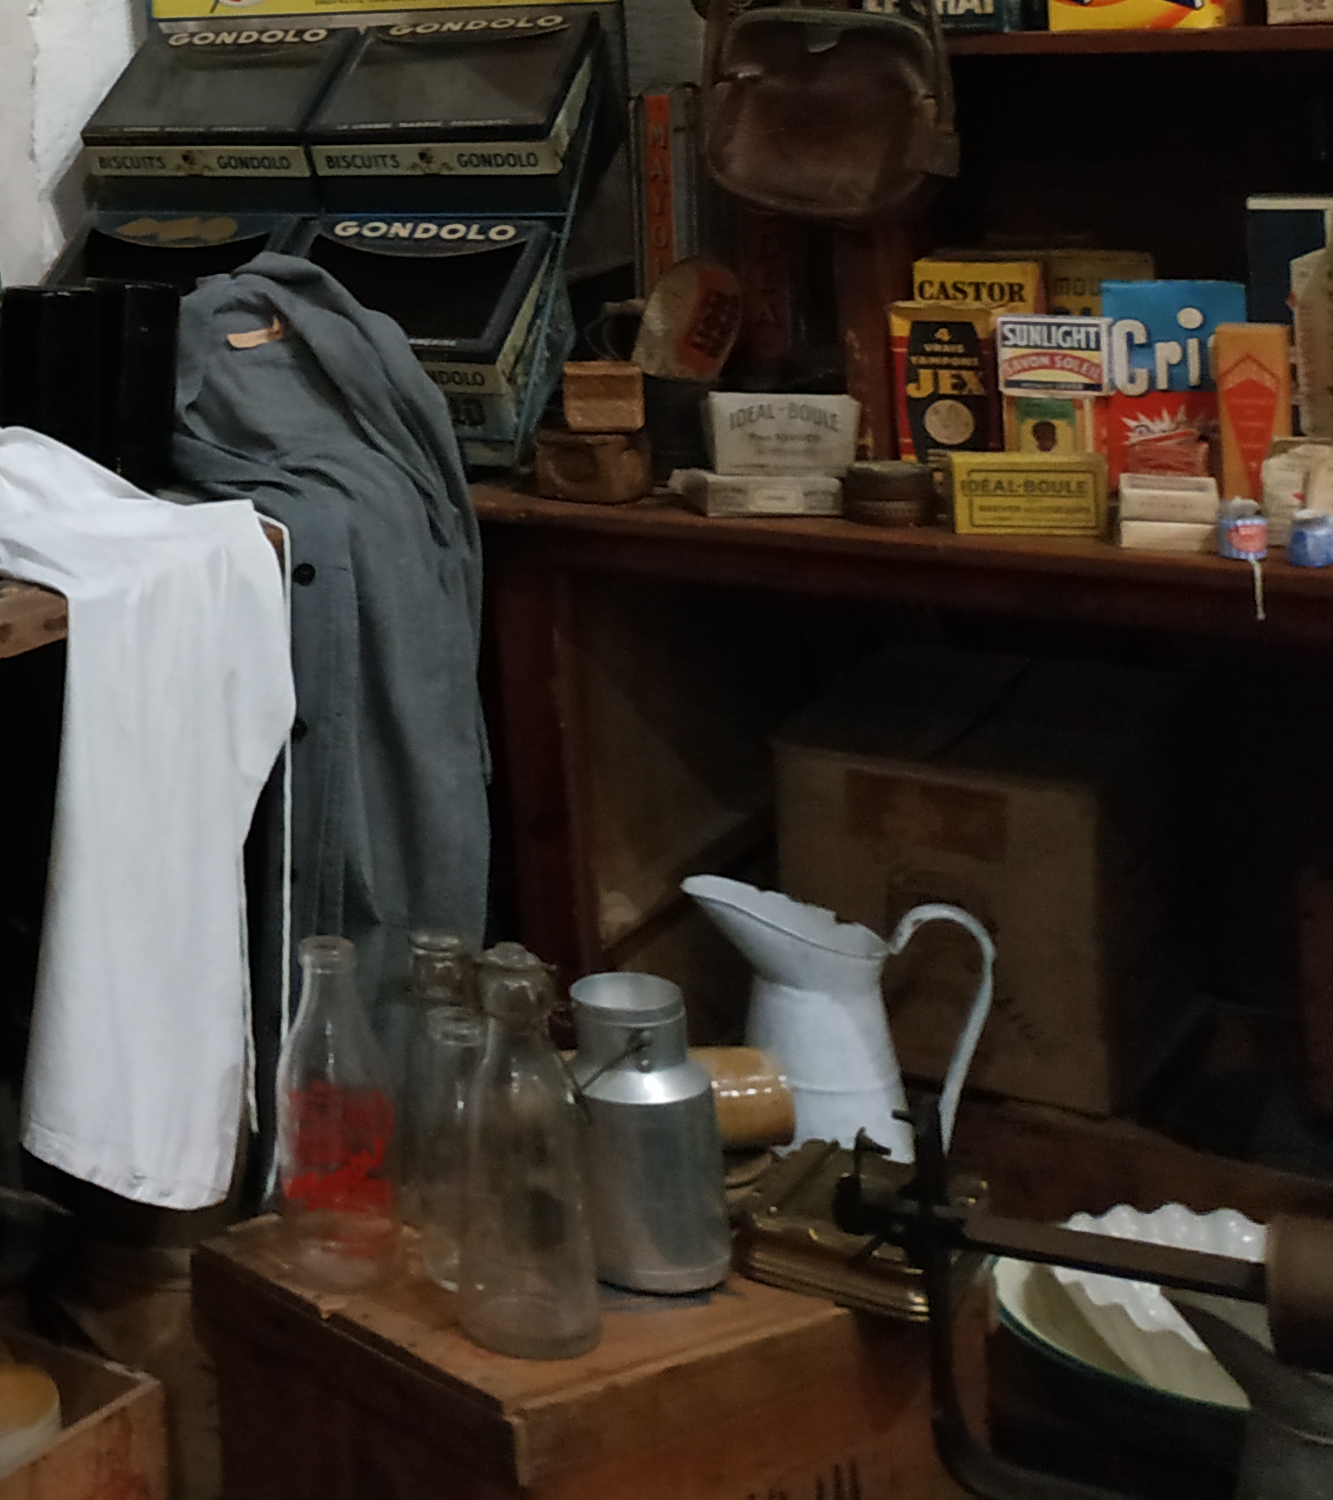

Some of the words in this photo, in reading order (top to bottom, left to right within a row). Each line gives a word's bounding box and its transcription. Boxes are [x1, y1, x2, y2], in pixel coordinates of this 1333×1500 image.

[168, 27, 330, 47] GONDOLO
[389, 13, 566, 37] GONDOLO
[98, 154, 168, 171] BISCUITS
[216, 153, 292, 172] GONDOLO
[324, 153, 401, 171] BISCUITS
[455, 151, 540, 169] GONDOLO
[332, 219, 519, 242] GONDOLO
[917, 279, 1027, 303] CASTOR
[1002, 323, 1100, 349] SUNLIGHT
[1112, 306, 1217, 397] Cri
[905, 368, 985, 399] JEX
